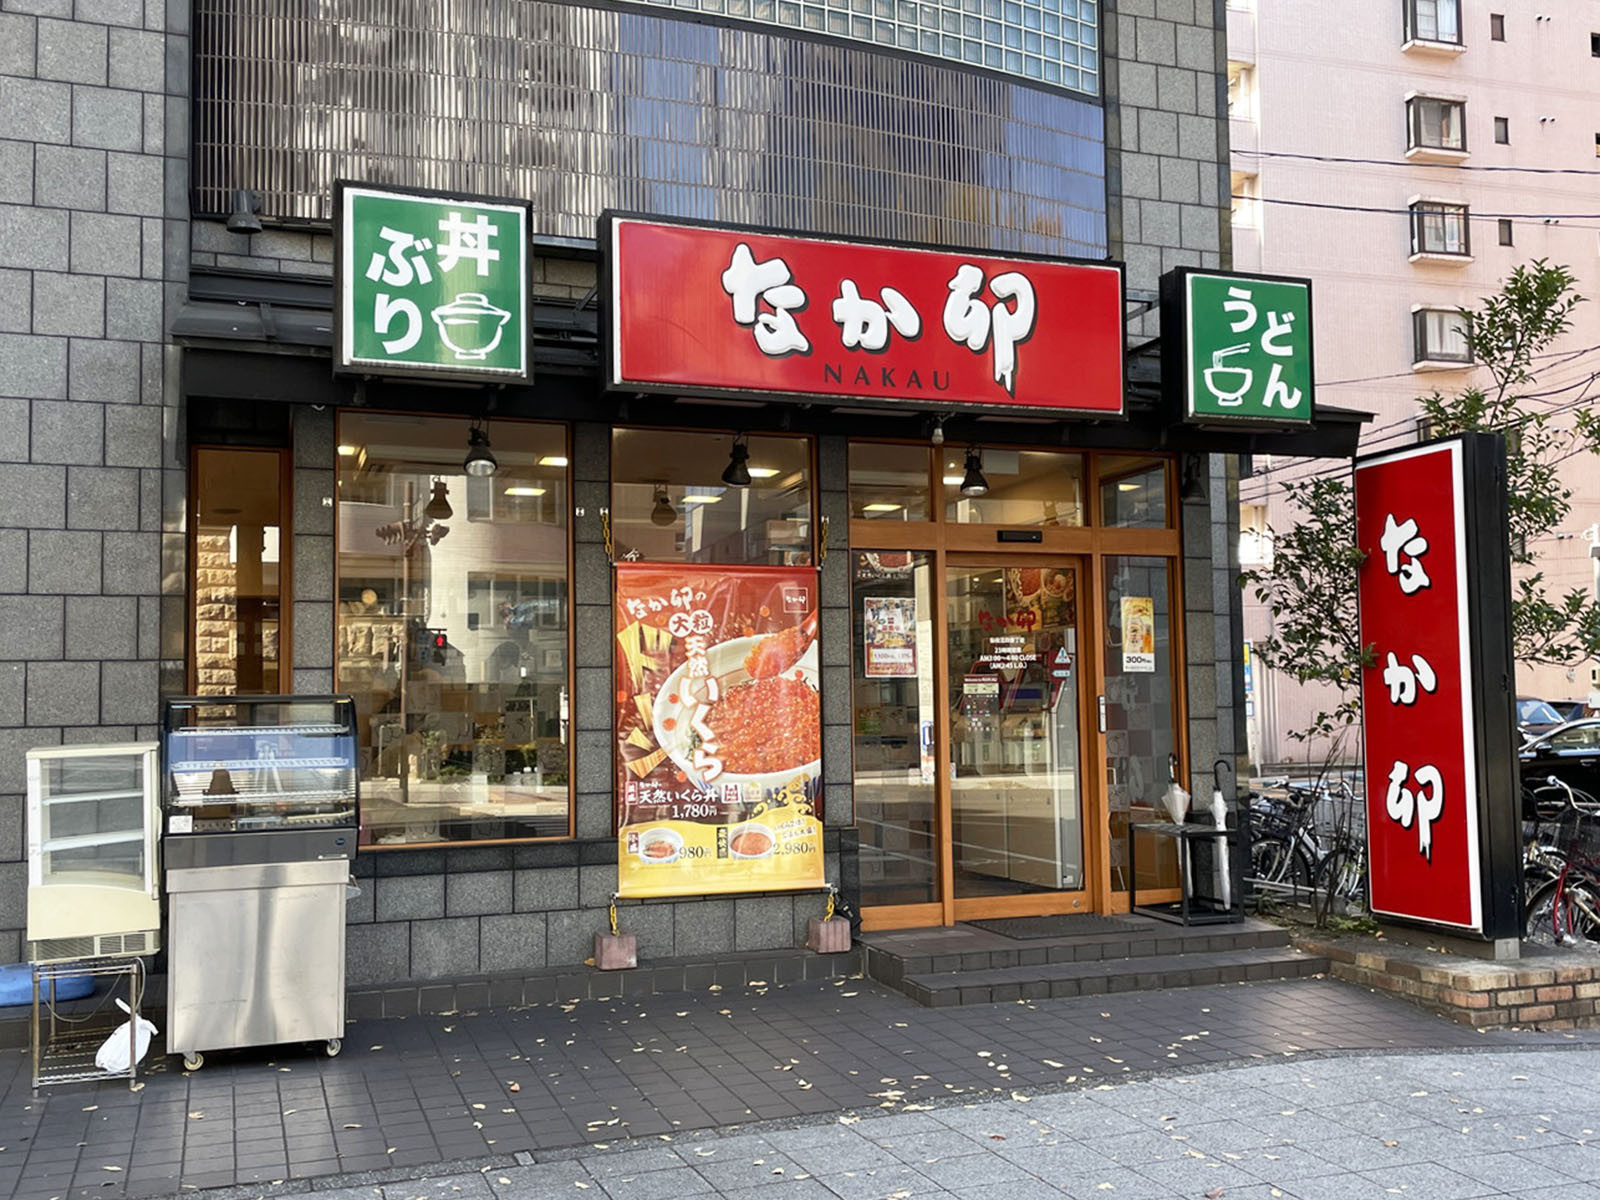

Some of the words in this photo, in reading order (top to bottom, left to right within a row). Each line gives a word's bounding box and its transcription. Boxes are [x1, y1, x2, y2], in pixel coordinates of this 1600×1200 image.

[721, 242, 1036, 396] なか卯
[1223, 286, 1303, 409] うどん
[824, 363, 950, 391] NAKAU
[626, 585, 708, 619] なか卯の
[670, 611, 712, 635] 大粒
[1380, 513, 1443, 862] なか卯
[680, 635, 723, 783] 天然いくら
[640, 788, 718, 803] 天然いくら丼
[672, 804, 717, 818] 1,780円
